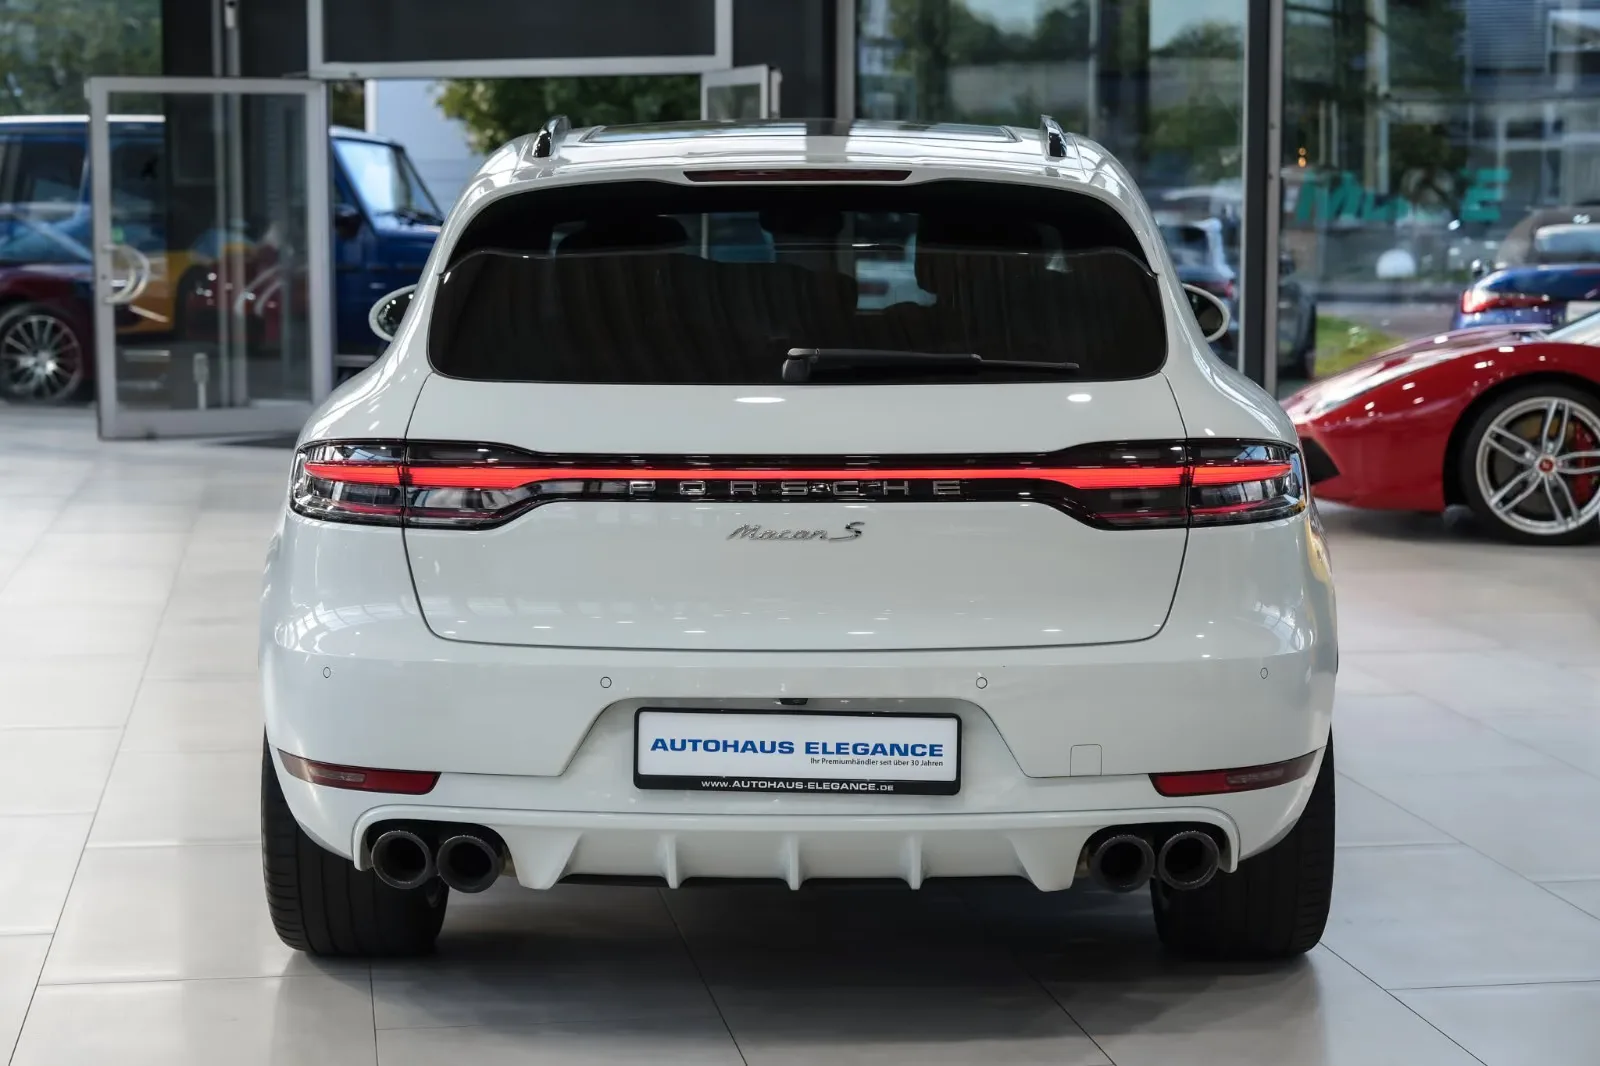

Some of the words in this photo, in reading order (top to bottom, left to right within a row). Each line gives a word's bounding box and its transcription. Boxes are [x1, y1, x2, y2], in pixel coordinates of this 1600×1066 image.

[628, 480, 961, 496] PORSCHE
[726, 524, 828, 540] Macan
[828, 521, 865, 542] S
[650, 738, 795, 755] AUTOHAUS
[804, 742, 944, 757] ELEGANCE
[810, 757, 820, 765] Ihr
[821, 757, 878, 766] Premiumhändler
[879, 758, 892, 766] seit
[893, 758, 909, 767] über
[910, 759, 920, 767] 30
[920, 759, 944, 767] Jahren
